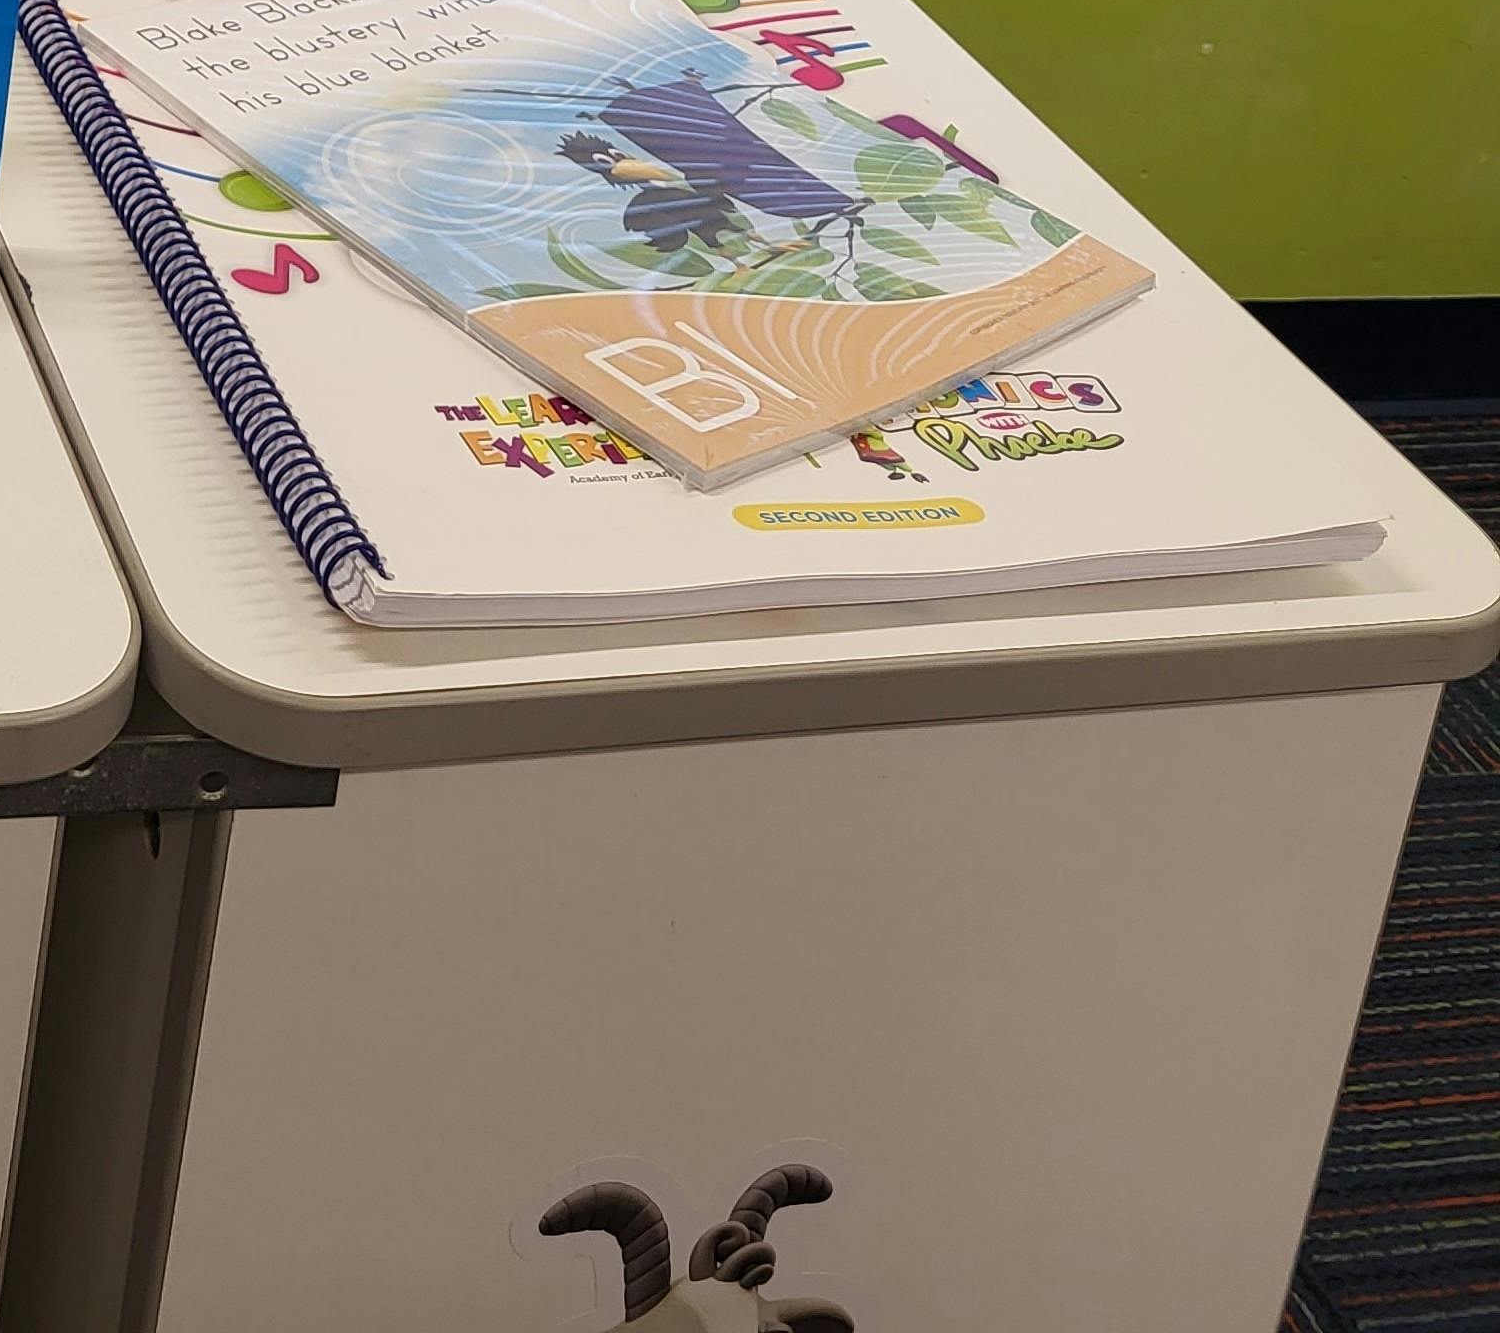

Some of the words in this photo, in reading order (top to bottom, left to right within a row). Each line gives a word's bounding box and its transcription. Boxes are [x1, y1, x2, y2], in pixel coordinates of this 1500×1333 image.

[136, 17, 243, 51] Blake
[182, 55, 251, 80] the
[253, 17, 407, 62] blustery
[219, 90, 283, 114] his
[284, 69, 370, 96] blue
[584, 320, 799, 434] Bl
[434, 405, 487, 422] THE
[883, 376, 1105, 423] ONICS
[978, 412, 1030, 429] WITH
[914, 416, 1125, 472] Phoebe
[569, 473, 629, 485] Academy
[631, 470, 645, 482] of
[757, 510, 858, 526] SECOND
[862, 505, 963, 524] EDITION
